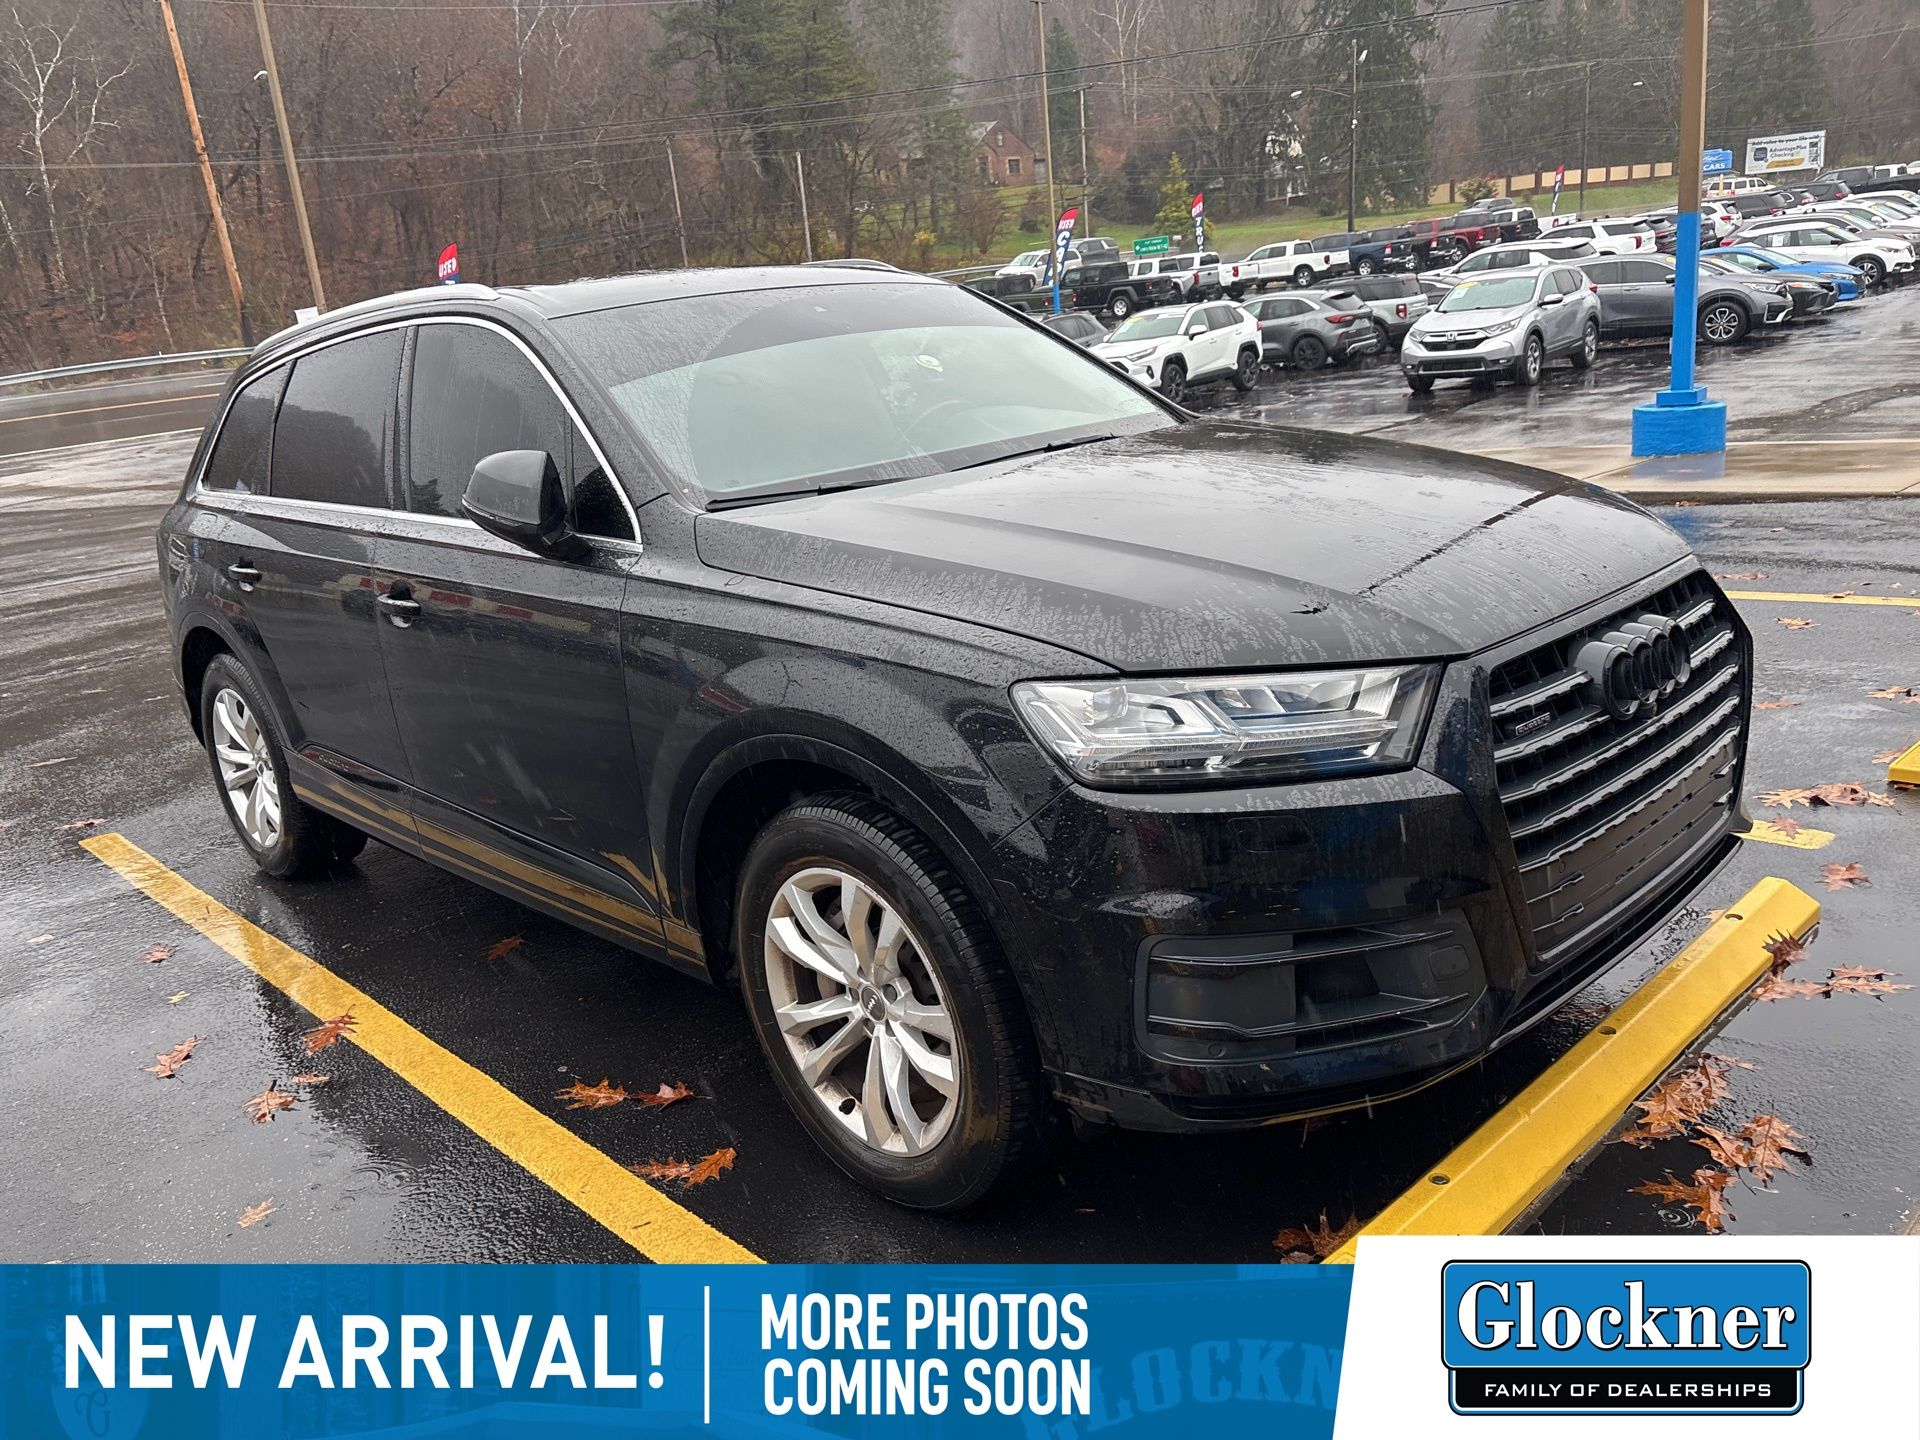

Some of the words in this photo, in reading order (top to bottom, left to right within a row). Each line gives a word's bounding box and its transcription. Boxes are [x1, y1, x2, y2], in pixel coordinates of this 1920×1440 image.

[1703, 163, 1726, 171] CARS
[1058, 218, 1075, 230] USED
[438, 256, 457, 278] USED
